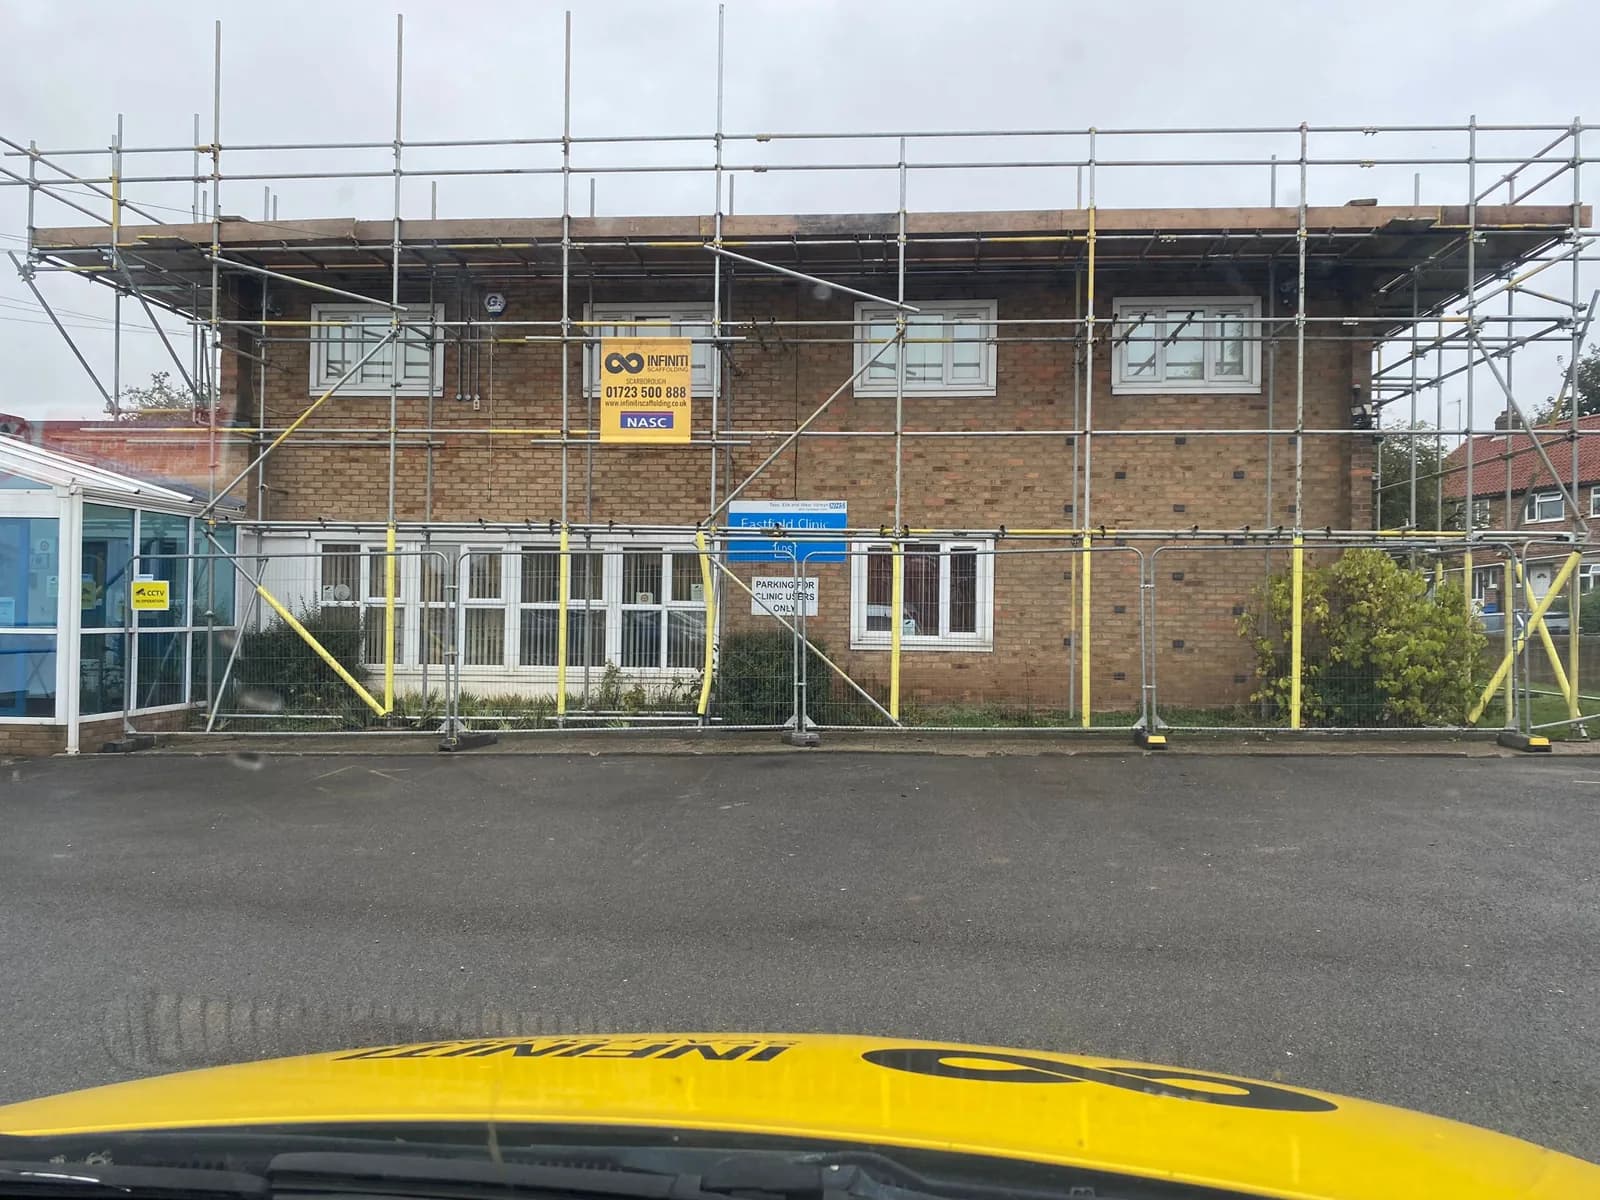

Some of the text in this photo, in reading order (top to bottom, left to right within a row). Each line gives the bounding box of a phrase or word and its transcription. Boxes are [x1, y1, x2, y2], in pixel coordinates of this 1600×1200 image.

[647, 355, 689, 367] INFINITI
[606, 386, 686, 398] 01723 500 888
[627, 417, 667, 428] NASC
[798, 518, 829, 528] Clinic
[755, 581, 794, 589] PARKING
[773, 604, 796, 612] ONLY
[331, 1043, 790, 1061] INFINITI
